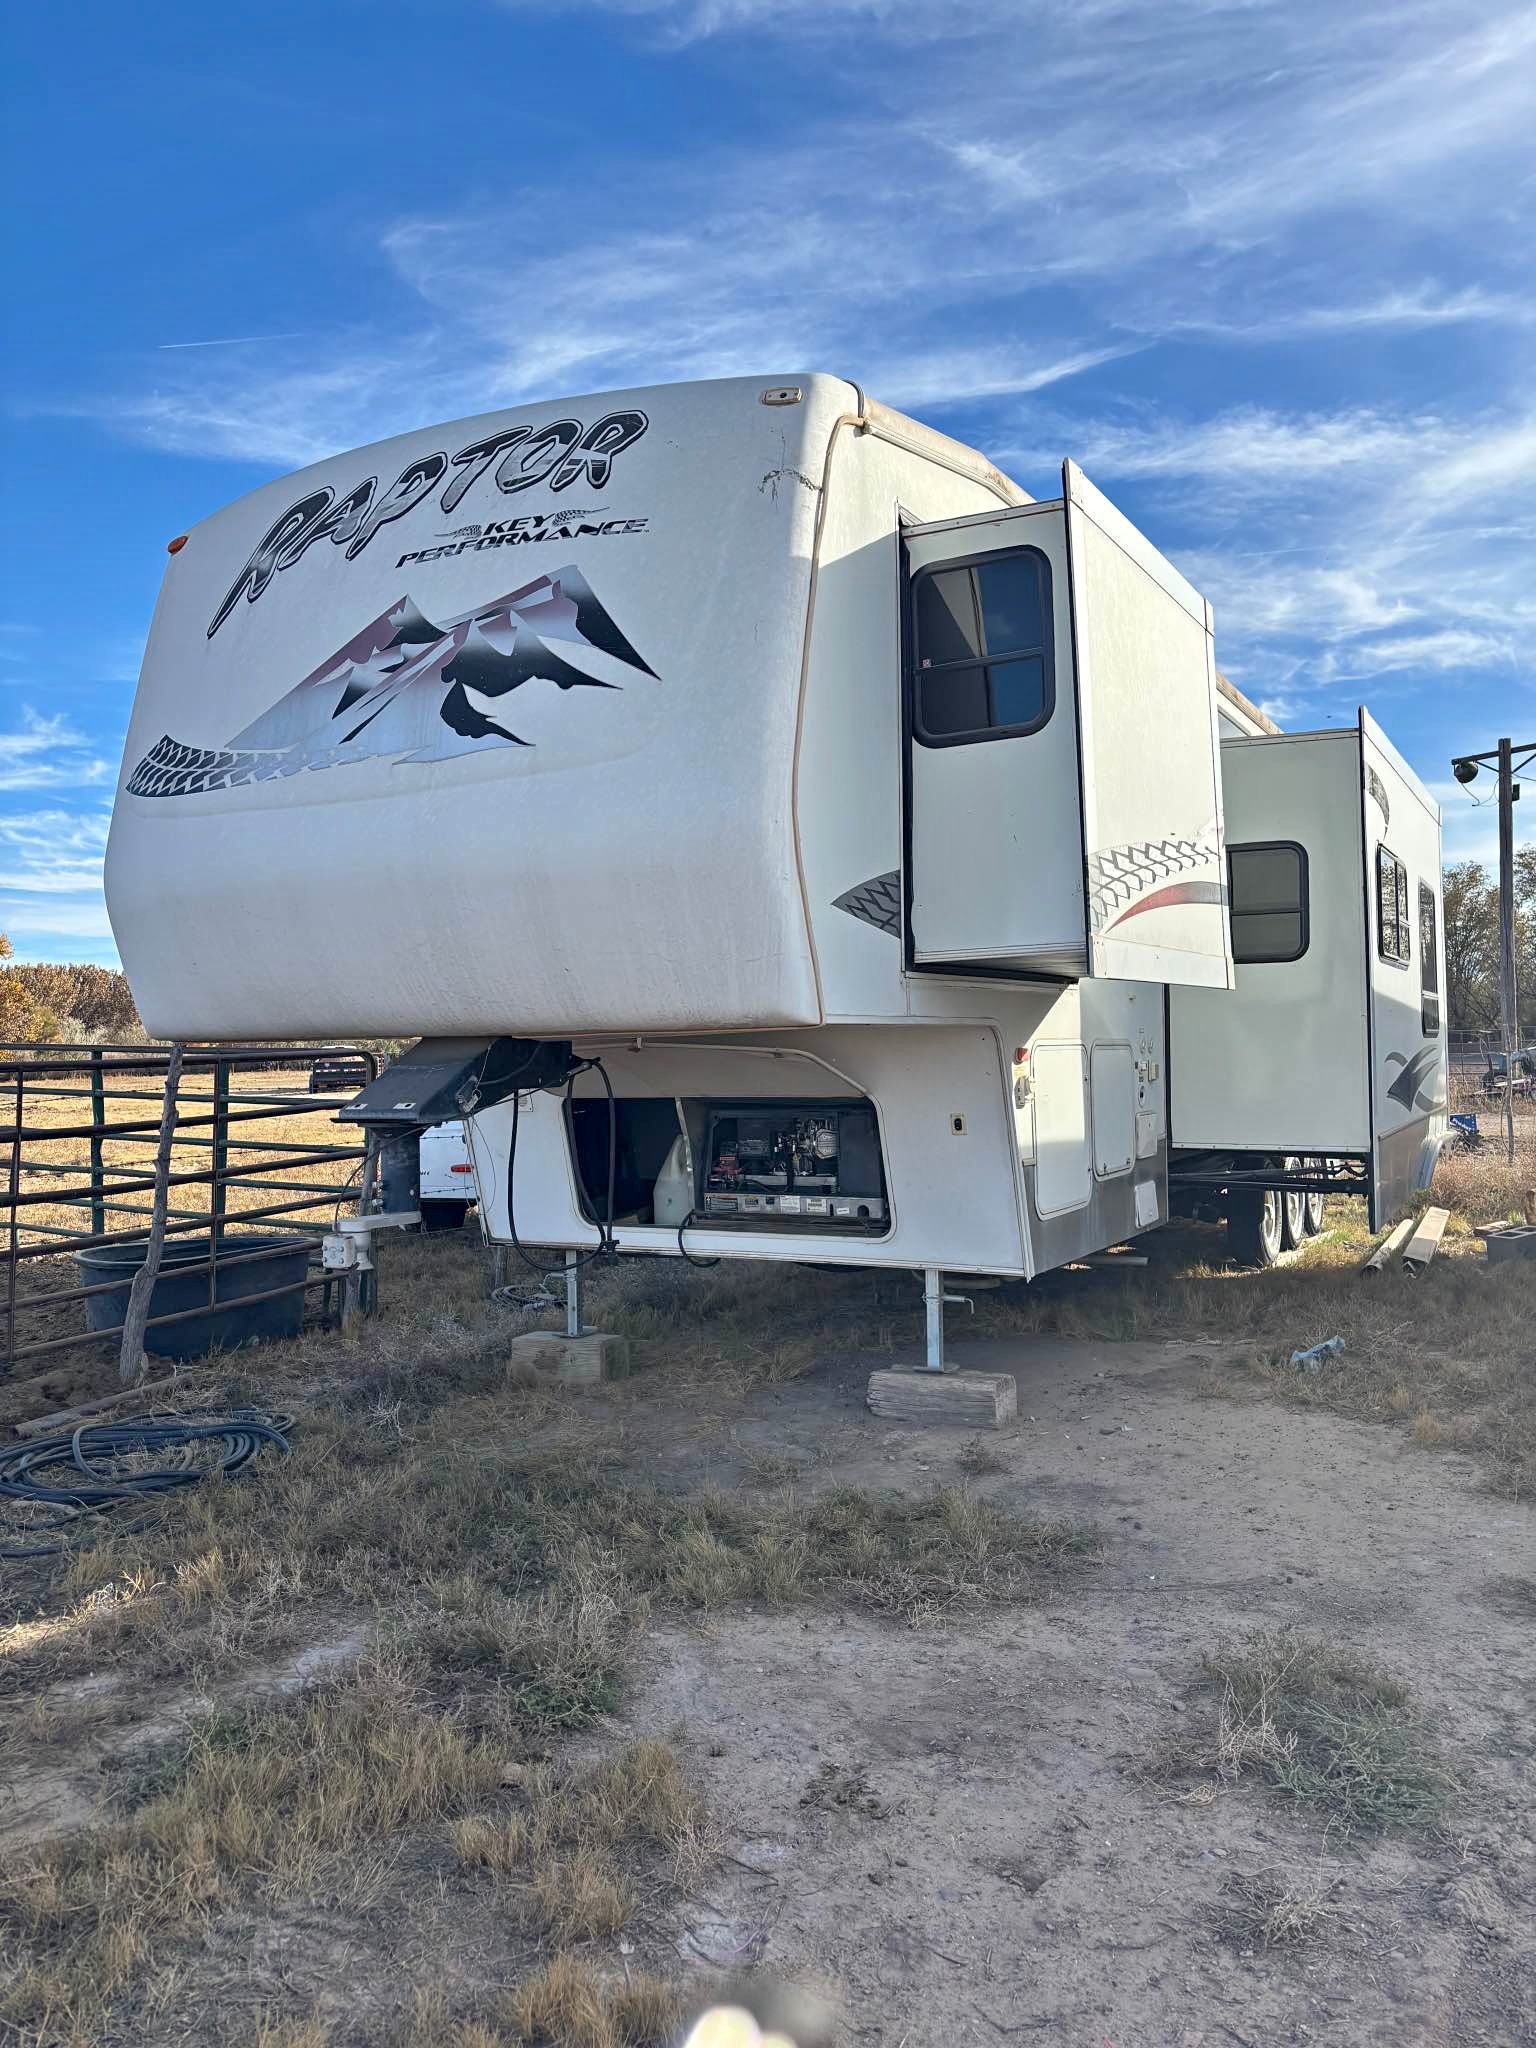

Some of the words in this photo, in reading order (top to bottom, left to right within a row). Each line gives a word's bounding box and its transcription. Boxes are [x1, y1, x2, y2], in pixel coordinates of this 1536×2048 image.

[207, 410, 649, 640] RAPTOR
[395, 518, 649, 568] PERFORMANCE
[481, 513, 555, 536] KEY
